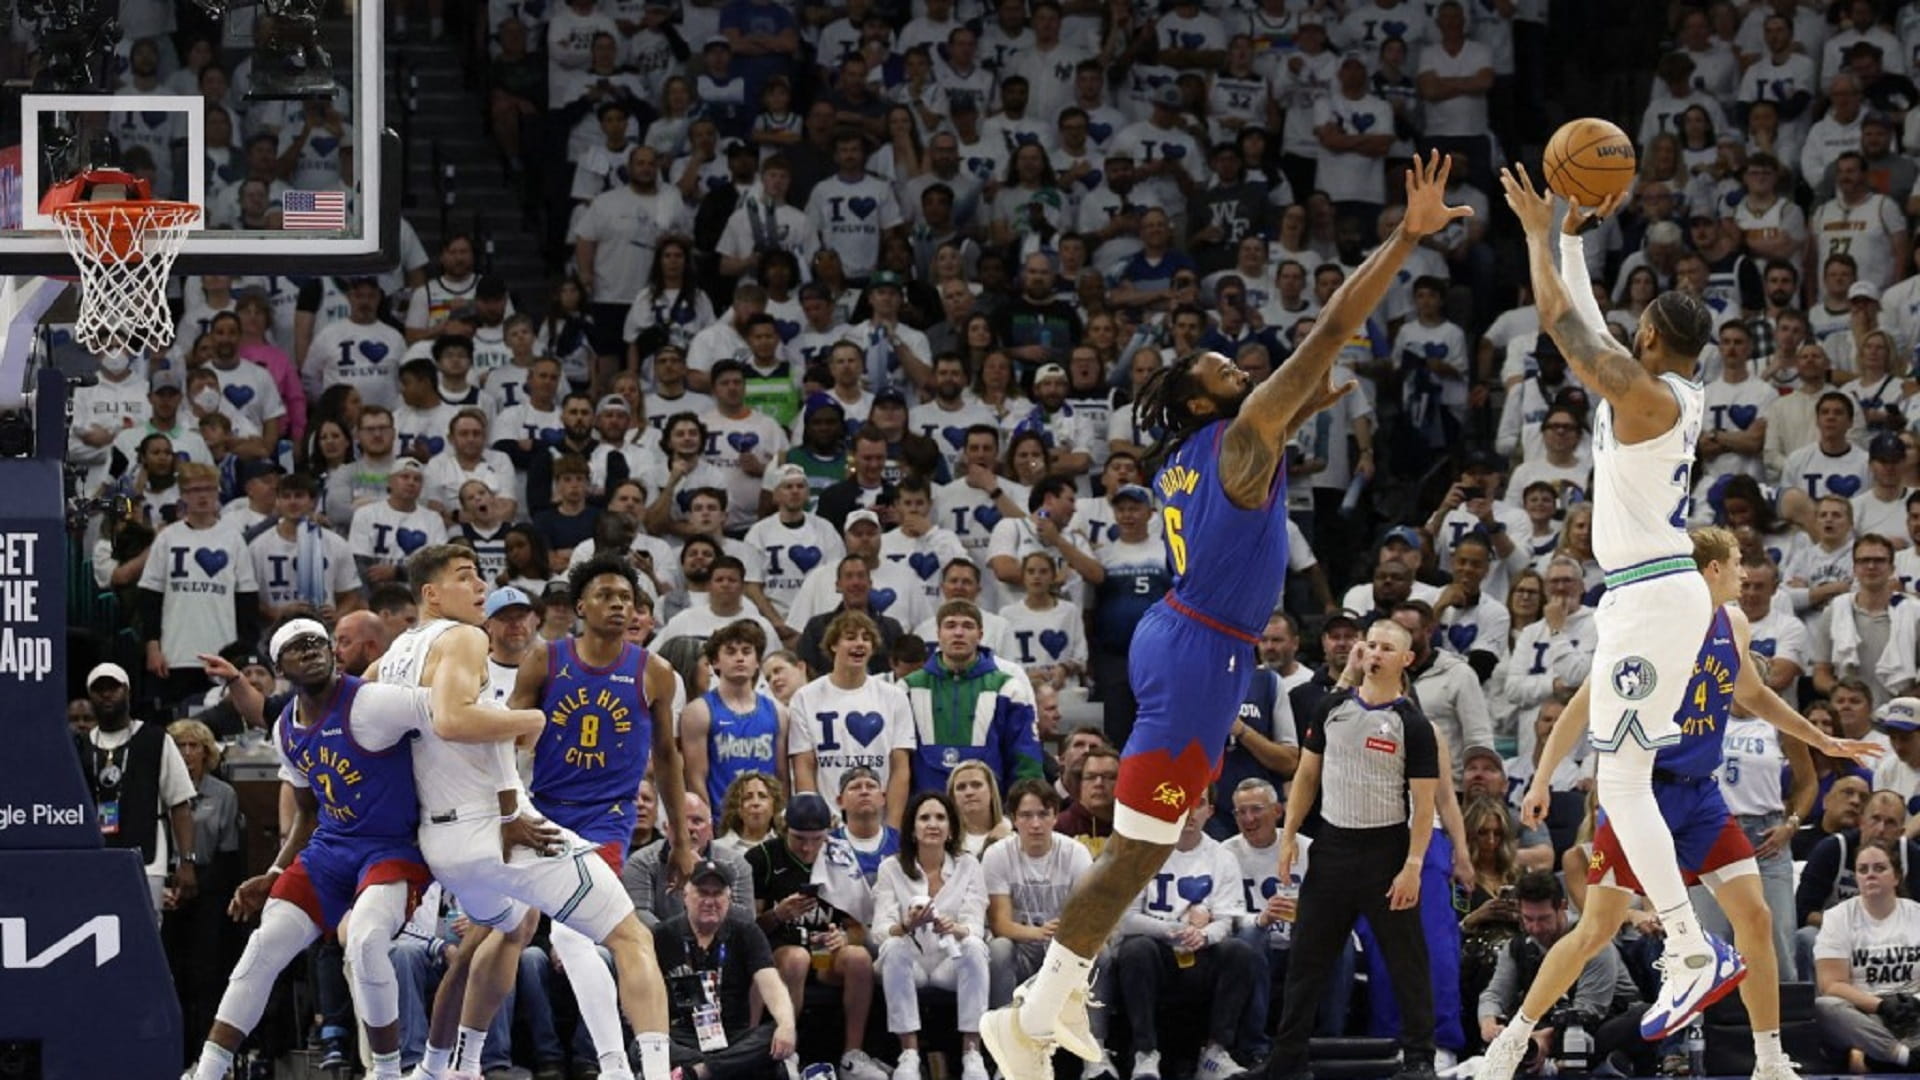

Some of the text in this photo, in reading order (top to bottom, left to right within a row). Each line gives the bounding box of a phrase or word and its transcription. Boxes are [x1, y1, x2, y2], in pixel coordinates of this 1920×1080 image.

[830, 198, 845, 221] I
[338, 341, 355, 366] I
[502, 383, 519, 406] I
[952, 507, 970, 534] I
[374, 524, 393, 553] I
[1163, 506, 1187, 576] 6
[170, 547, 190, 578] I
[268, 556, 289, 587] I
[767, 546, 785, 575] I
[1134, 576, 1151, 594] 5
[0, 580, 39, 622] HE
[0, 627, 52, 681] App
[1016, 631, 1035, 663] I
[1529, 642, 1550, 675] I
[1703, 654, 1734, 695] HIGH
[551, 687, 632, 733] MILE HIGH
[1694, 681, 1708, 712] 4
[580, 714, 600, 748] 8
[816, 711, 841, 750] I
[1681, 714, 1716, 736] CITY
[320, 745, 363, 786] HIGH
[565, 746, 606, 770] CITY
[818, 755, 885, 768] WOLVES
[1726, 757, 1740, 785] 5
[316, 773, 336, 803] 7
[33, 804, 84, 825] Pixel
[1149, 873, 1175, 912] I
[1865, 963, 1914, 984] BACK
